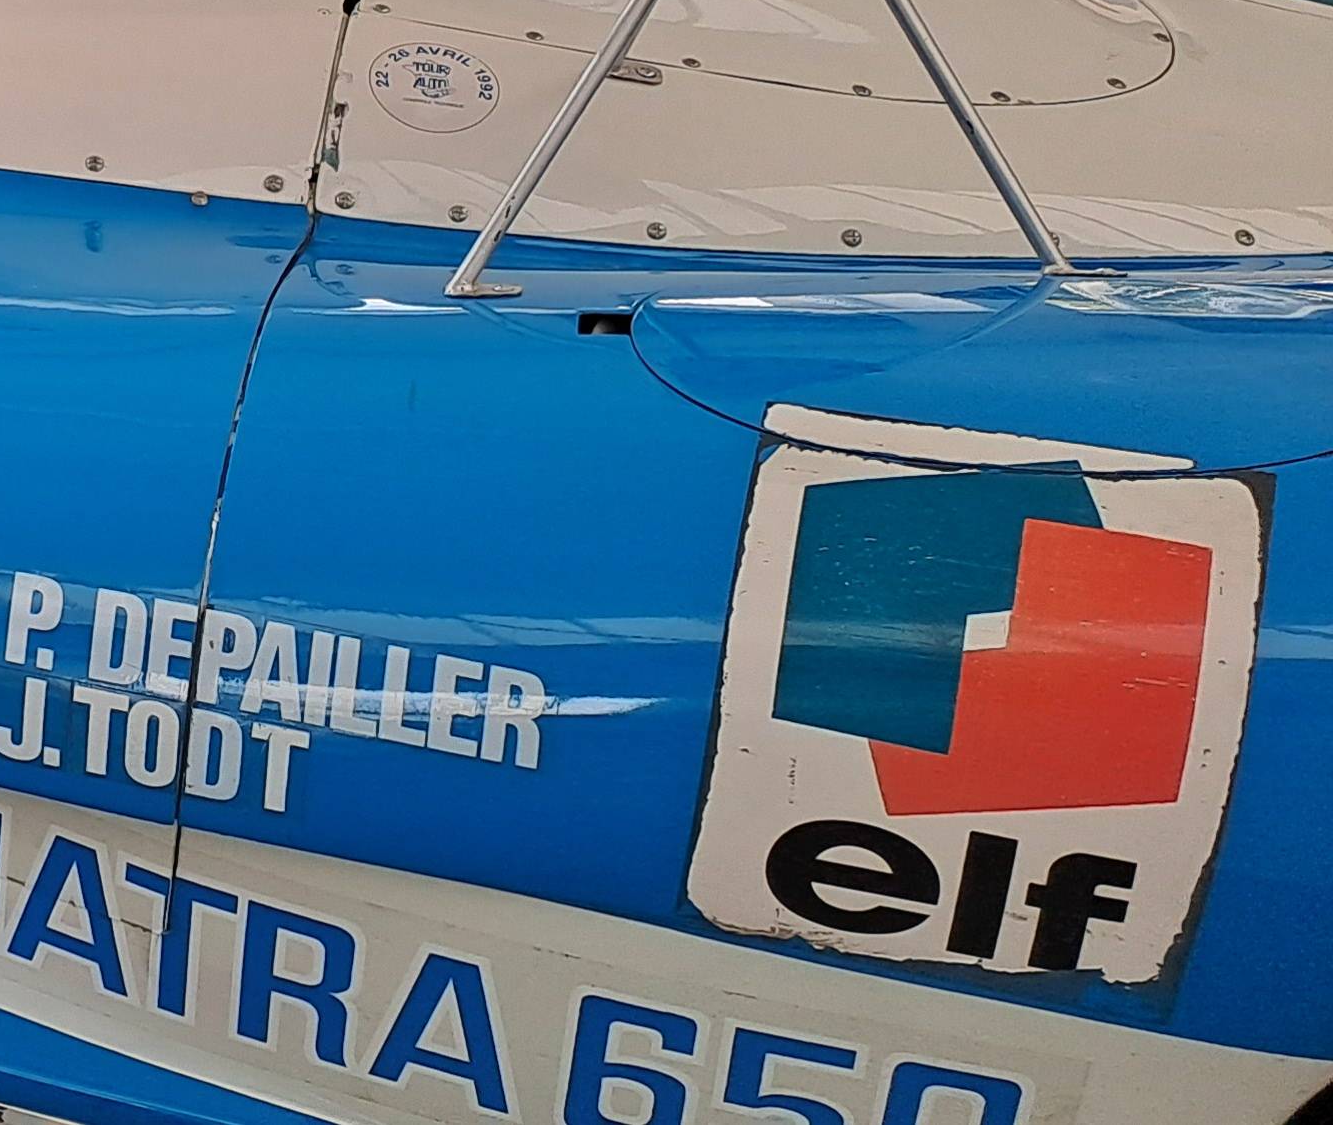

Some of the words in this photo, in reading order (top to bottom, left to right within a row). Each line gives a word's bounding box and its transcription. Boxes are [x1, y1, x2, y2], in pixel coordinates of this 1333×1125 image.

[413, 61, 451, 75] TOUR
[415, 46, 472, 67] AVRIL
[474, 68, 493, 101] 1992
[4, 571, 64, 671] P.
[88, 588, 546, 768] DEPAILLER
[765, 819, 1138, 972] elf
